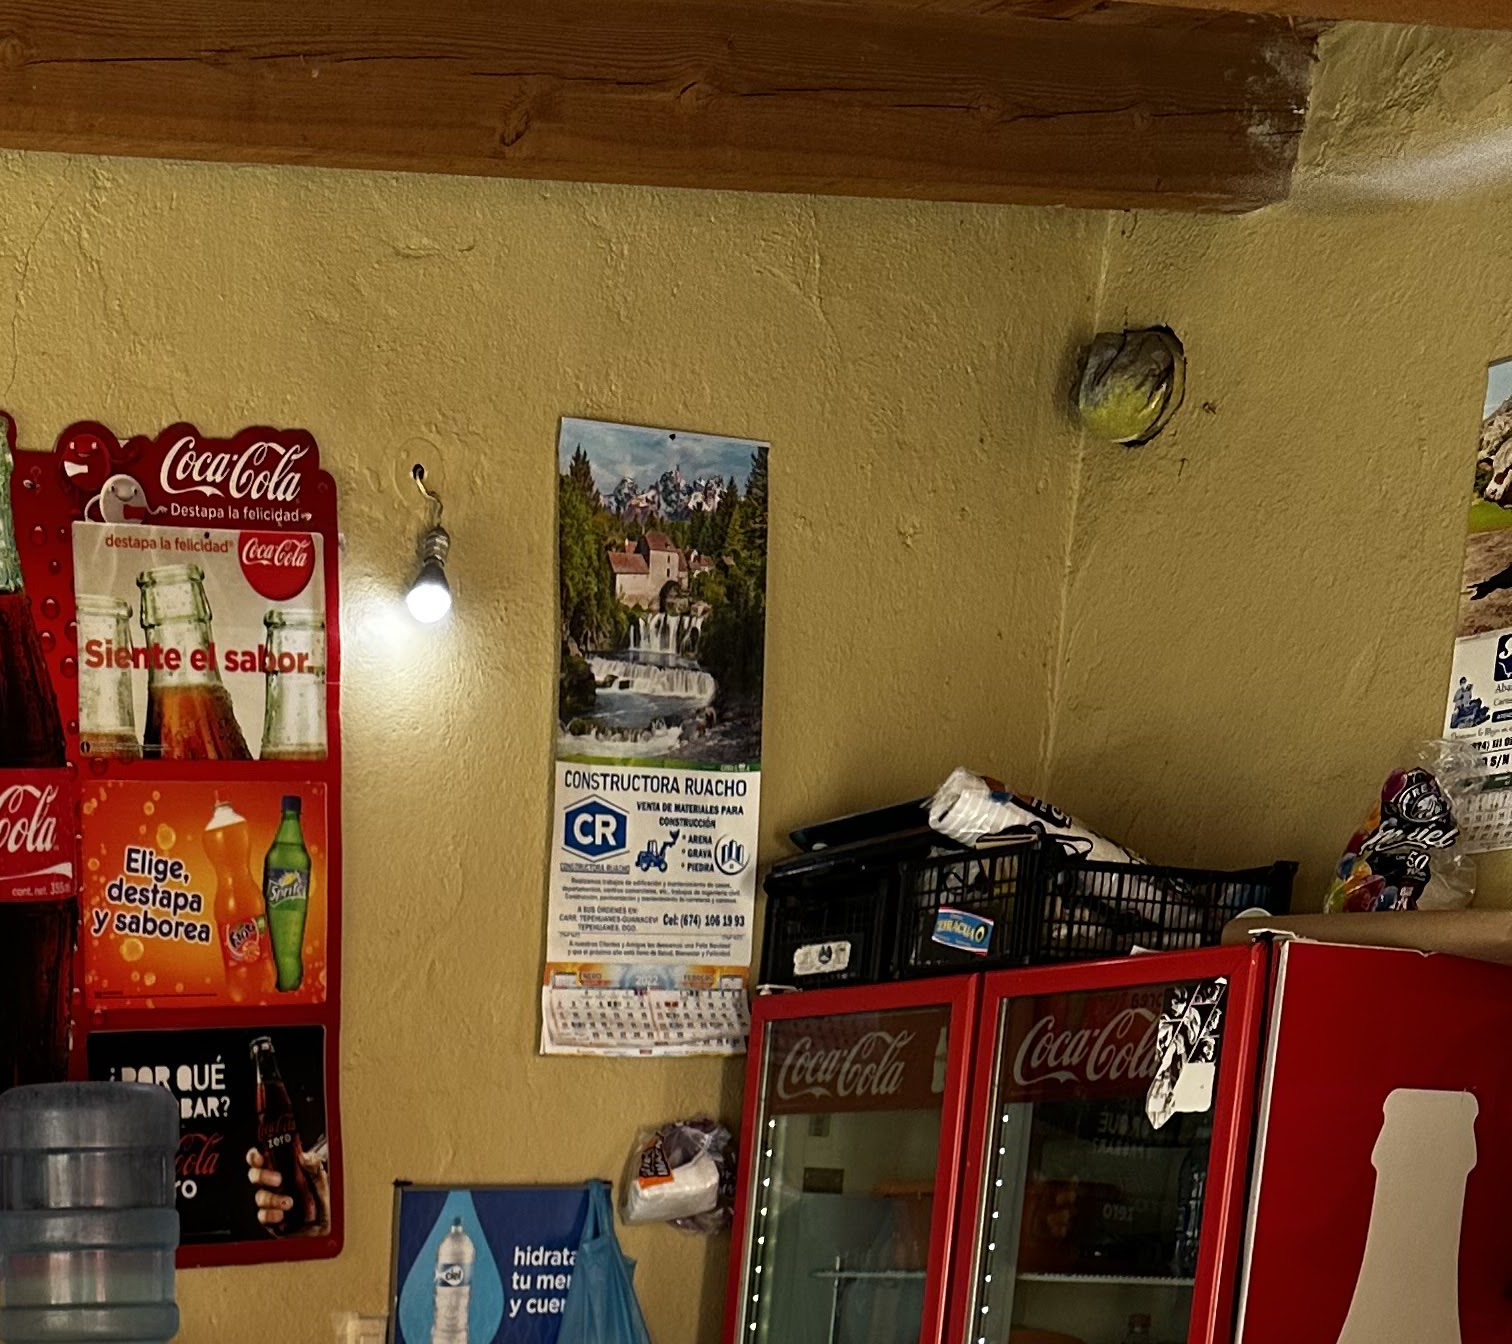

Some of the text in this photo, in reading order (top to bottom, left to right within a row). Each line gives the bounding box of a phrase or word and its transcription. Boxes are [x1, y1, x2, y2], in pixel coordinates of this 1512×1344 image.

[160, 436, 309, 502] Coca-Cola
[171, 503, 299, 522] Destapa la felicidad
[106, 534, 157, 550] destapa
[160, 536, 171, 549] la
[242, 537, 310, 567] Coca-Cola
[85, 639, 314, 673] Siente el sabor.
[565, 770, 747, 797] CONSTRUCTORA RUACHO
[637, 802, 743, 815] VENTA DE MATERIALES PARA
[574, 813, 617, 846] CR
[659, 817, 716, 828] CONSTRUCCIÓN
[688, 835, 712, 844] ARENA
[126, 847, 189, 883] Elige,
[688, 849, 712, 858] GRAVA
[687, 863, 714, 872] PIEDRA
[107, 879, 202, 916] destapa
[93, 910, 211, 943] y saborea
[681, 914, 701, 928] (674)
[705, 915, 720, 926] 106
[723, 915, 732, 926] 19
[735, 915, 744, 926] 93
[177, 1055, 226, 1091] QUÉ
[777, 1030, 916, 1100] Coca-Cola
[512, 1272, 530, 1290] tu
[509, 1299, 521, 1318] y
